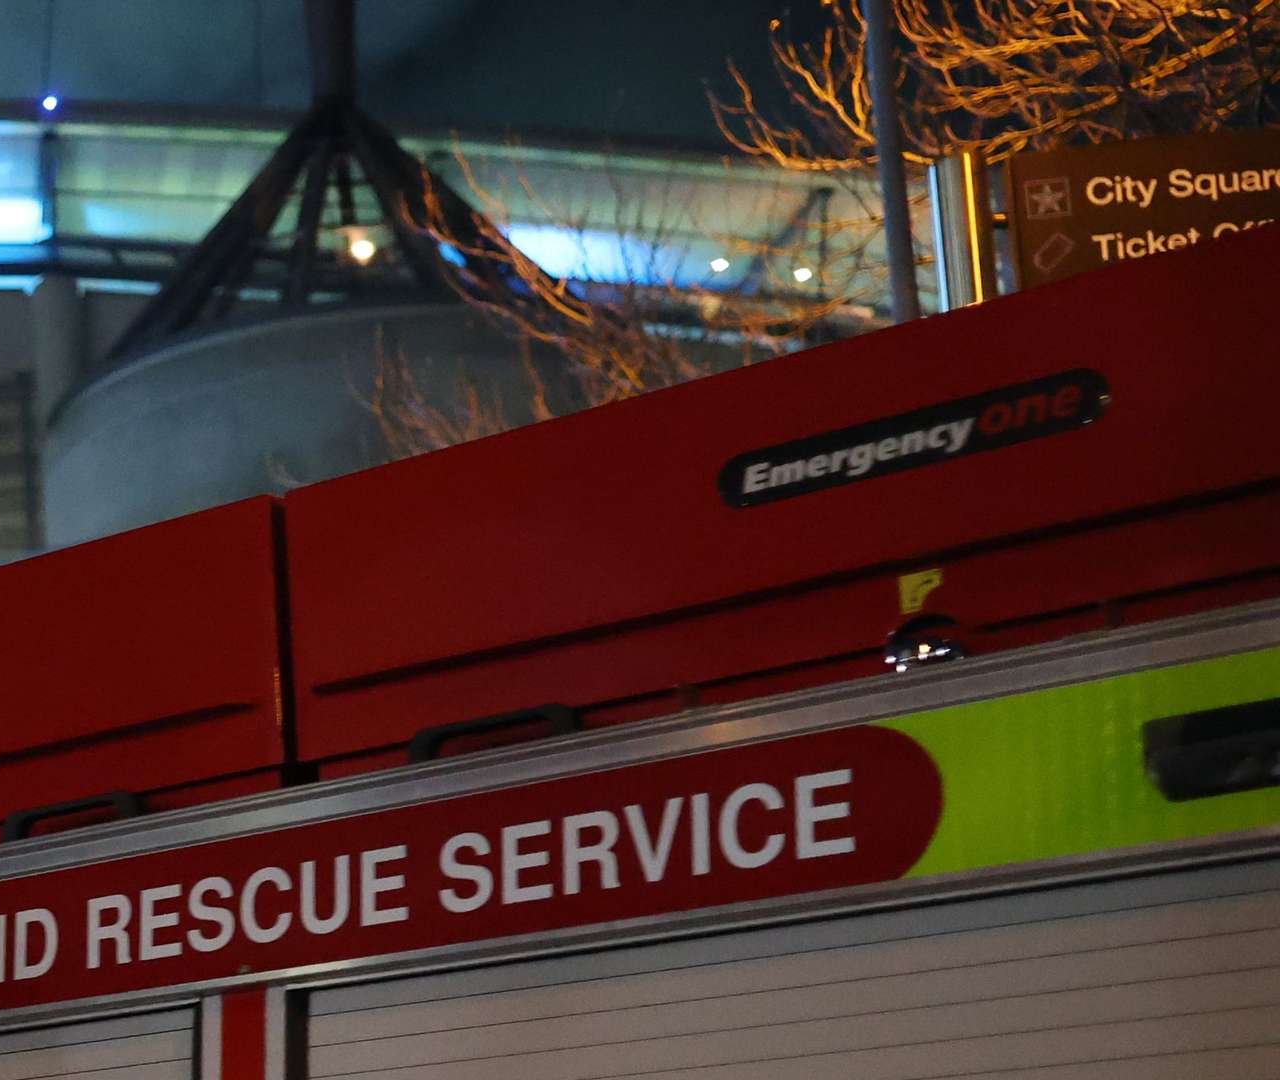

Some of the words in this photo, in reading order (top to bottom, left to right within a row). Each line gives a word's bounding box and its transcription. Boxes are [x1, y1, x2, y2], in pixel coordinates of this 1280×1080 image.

[1085, 174, 1158, 208] City
[1090, 227, 1201, 261] Ticket
[742, 416, 977, 495] Emergency
[979, 383, 1084, 435] one
[86, 844, 410, 970] RESCUE
[438, 767, 857, 914] SERVICE
